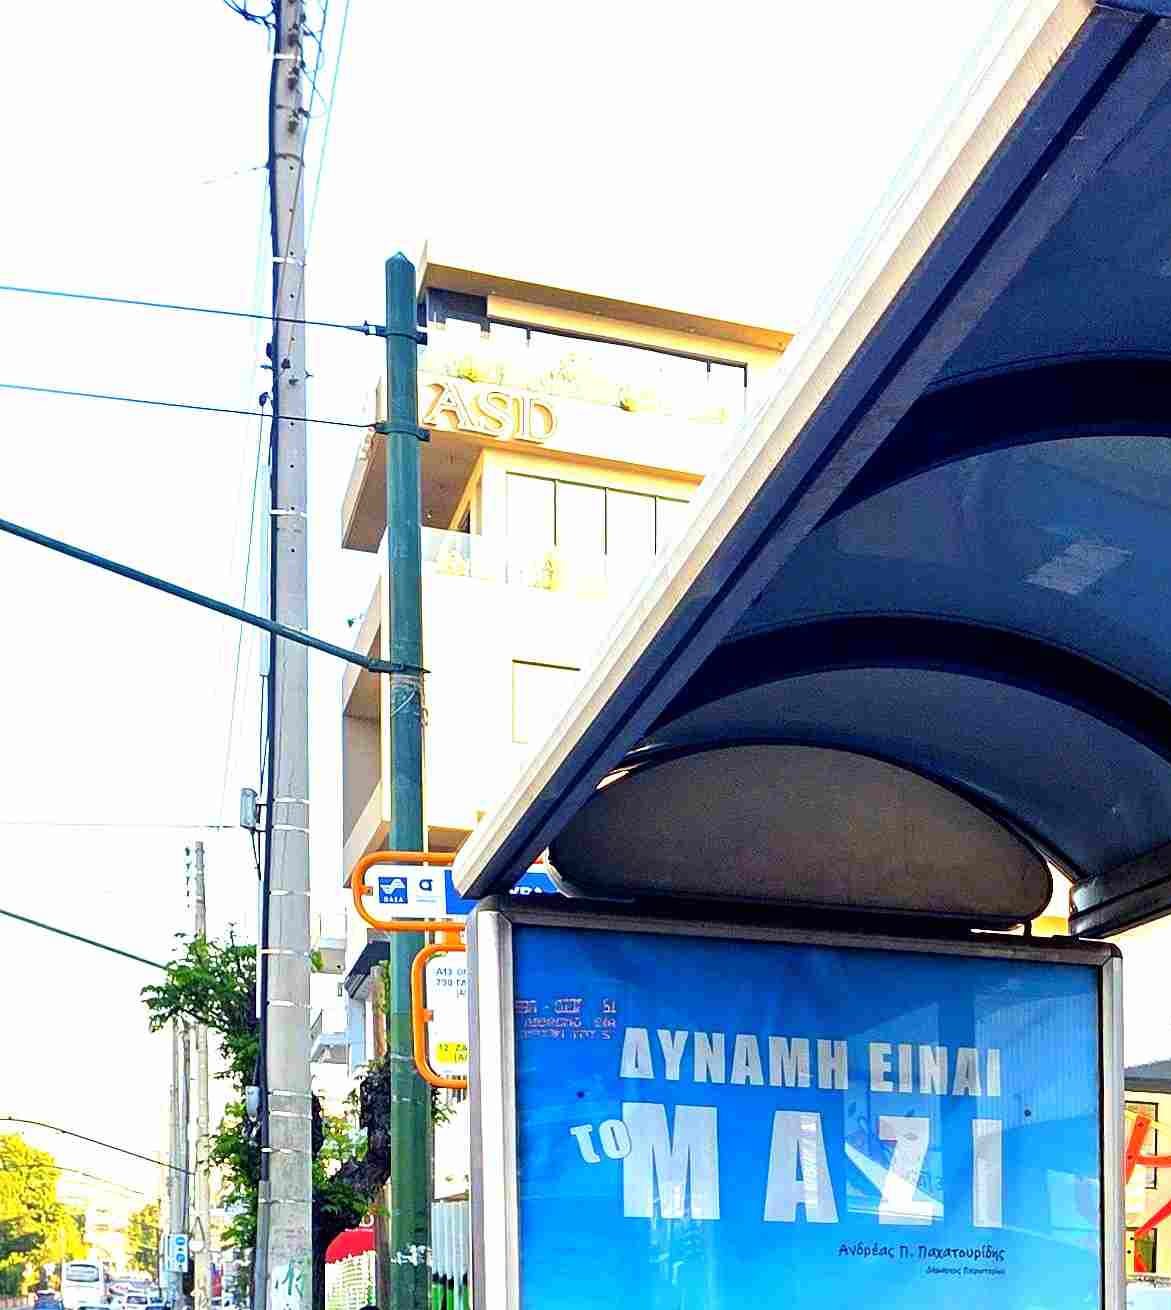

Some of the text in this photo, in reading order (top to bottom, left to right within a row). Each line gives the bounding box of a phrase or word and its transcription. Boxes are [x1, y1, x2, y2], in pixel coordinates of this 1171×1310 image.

[620, 1027, 1001, 1097] ΔΥΝΑΜΗ ΕΙΝΑΙ
[570, 1118, 632, 1164] το
[622, 1102, 1002, 1228] ΜΑΖΙ
[838, 1241, 895, 1258] Ανδρέας
[918, 1244, 1005, 1262] Παχατουρίδης
